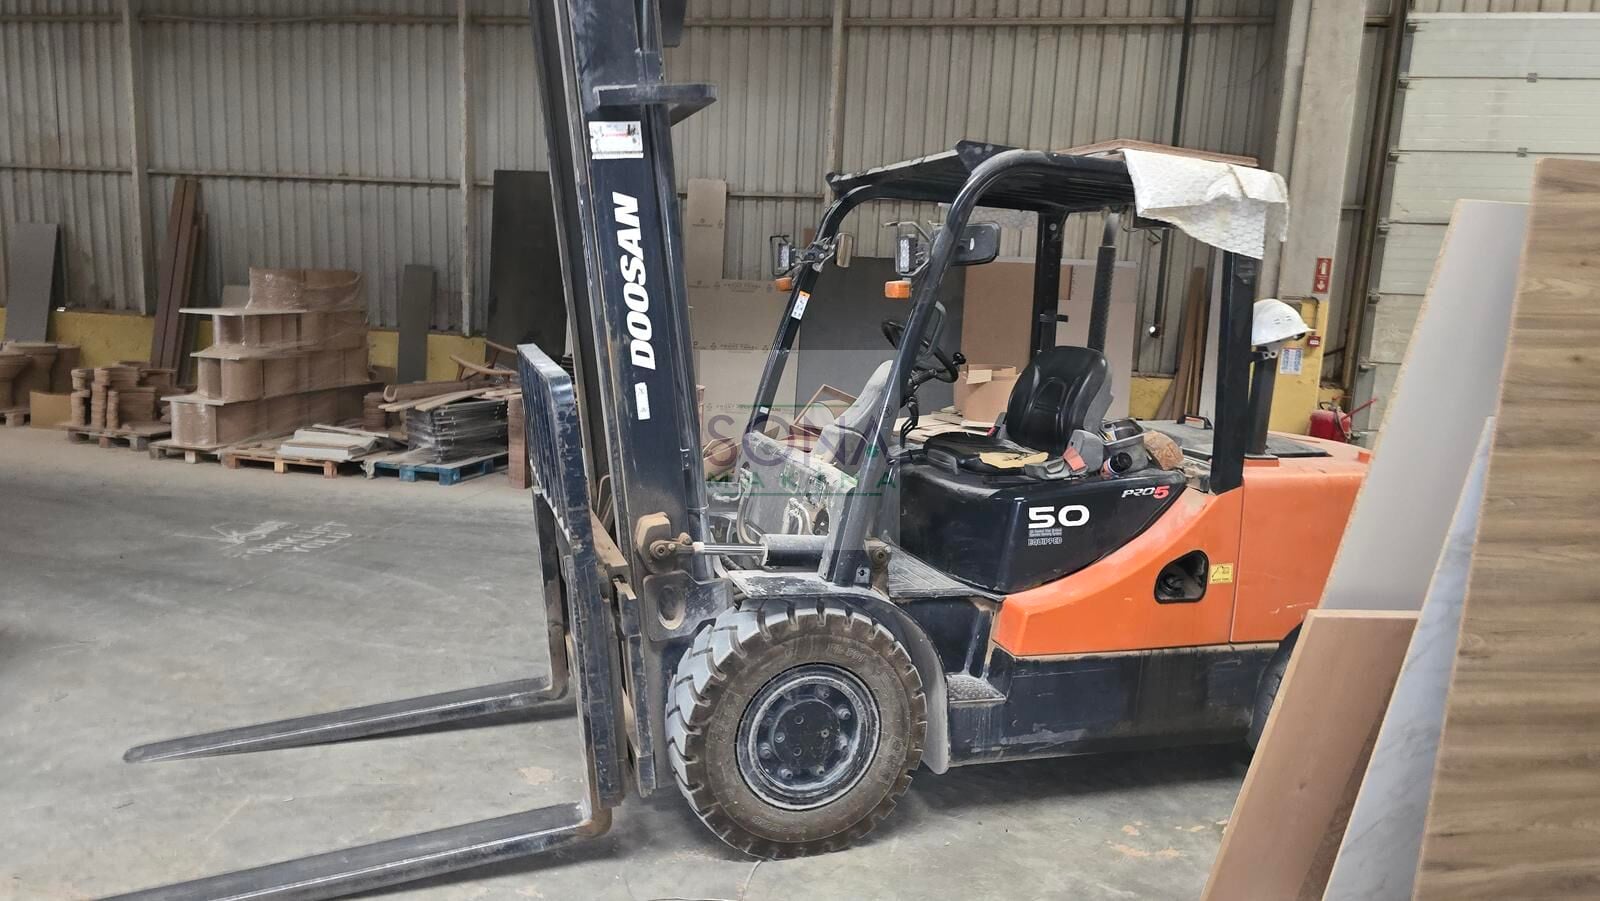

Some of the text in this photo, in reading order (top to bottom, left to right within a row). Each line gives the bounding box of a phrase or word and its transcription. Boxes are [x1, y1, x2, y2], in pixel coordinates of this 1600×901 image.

[612, 191, 656, 370] DOOSAN
[1121, 485, 1169, 498] PRO5
[1028, 505, 1090, 528] 50
[1028, 537, 1063, 546] EQUIPPED
